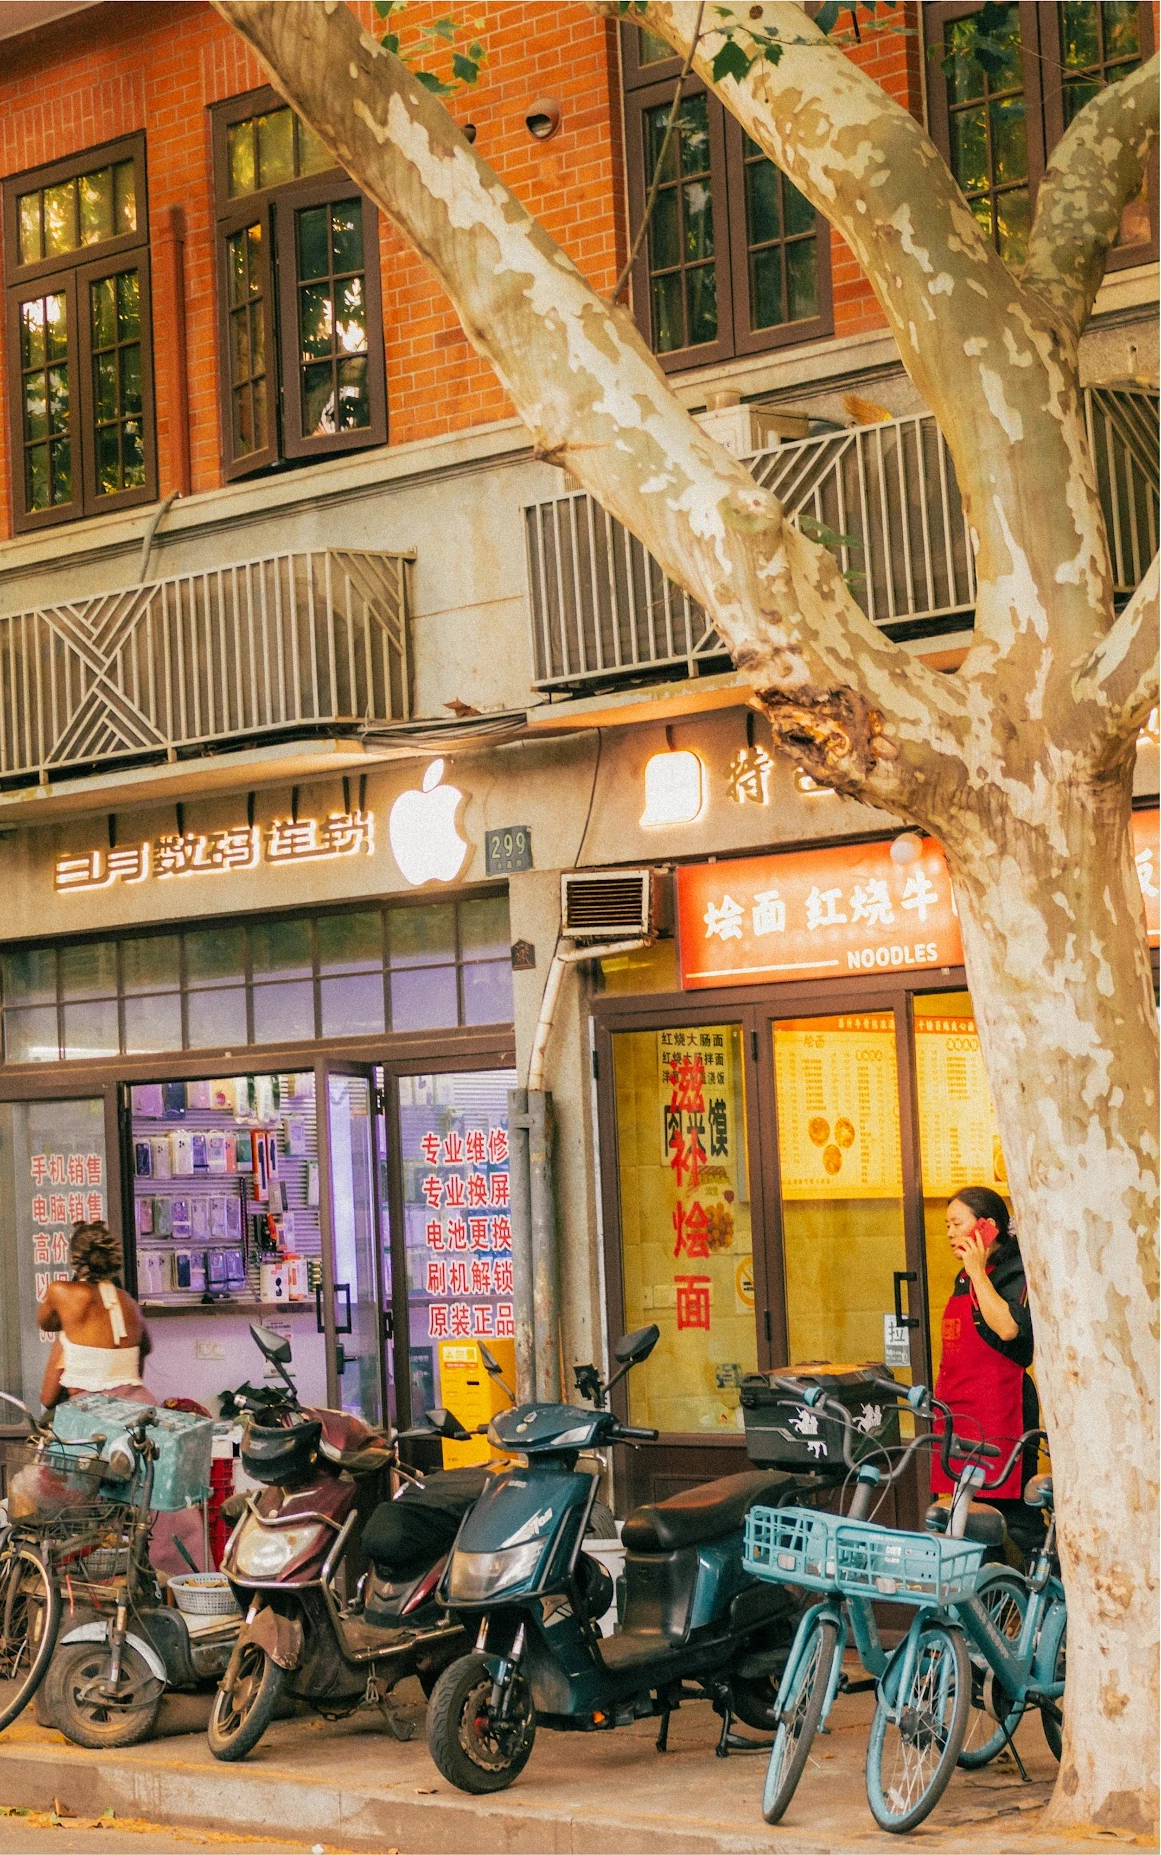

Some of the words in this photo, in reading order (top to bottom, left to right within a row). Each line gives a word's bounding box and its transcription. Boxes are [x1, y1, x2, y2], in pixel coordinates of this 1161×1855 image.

[491, 831, 526, 859] 299
[703, 890, 787, 941] 烩面
[805, 869, 959, 931] 红烧牛
[847, 942, 939, 970] NOODLES
[661, 1032, 724, 1048] 红烧大肠面
[664, 1098, 729, 1158] 肉夹馍
[420, 1127, 510, 1166] 专业维修
[30, 1153, 103, 1187] 手机销售
[422, 1172, 511, 1209] 专业换屏
[32, 1192, 105, 1226] 电脑销售
[33, 1231, 71, 1265] 高价
[425, 1215, 513, 1251] 电池更换
[427, 1259, 515, 1296] 刷机解锁
[428, 1302, 516, 1339] 原装正品
[888, 1321, 906, 1343] 拉
